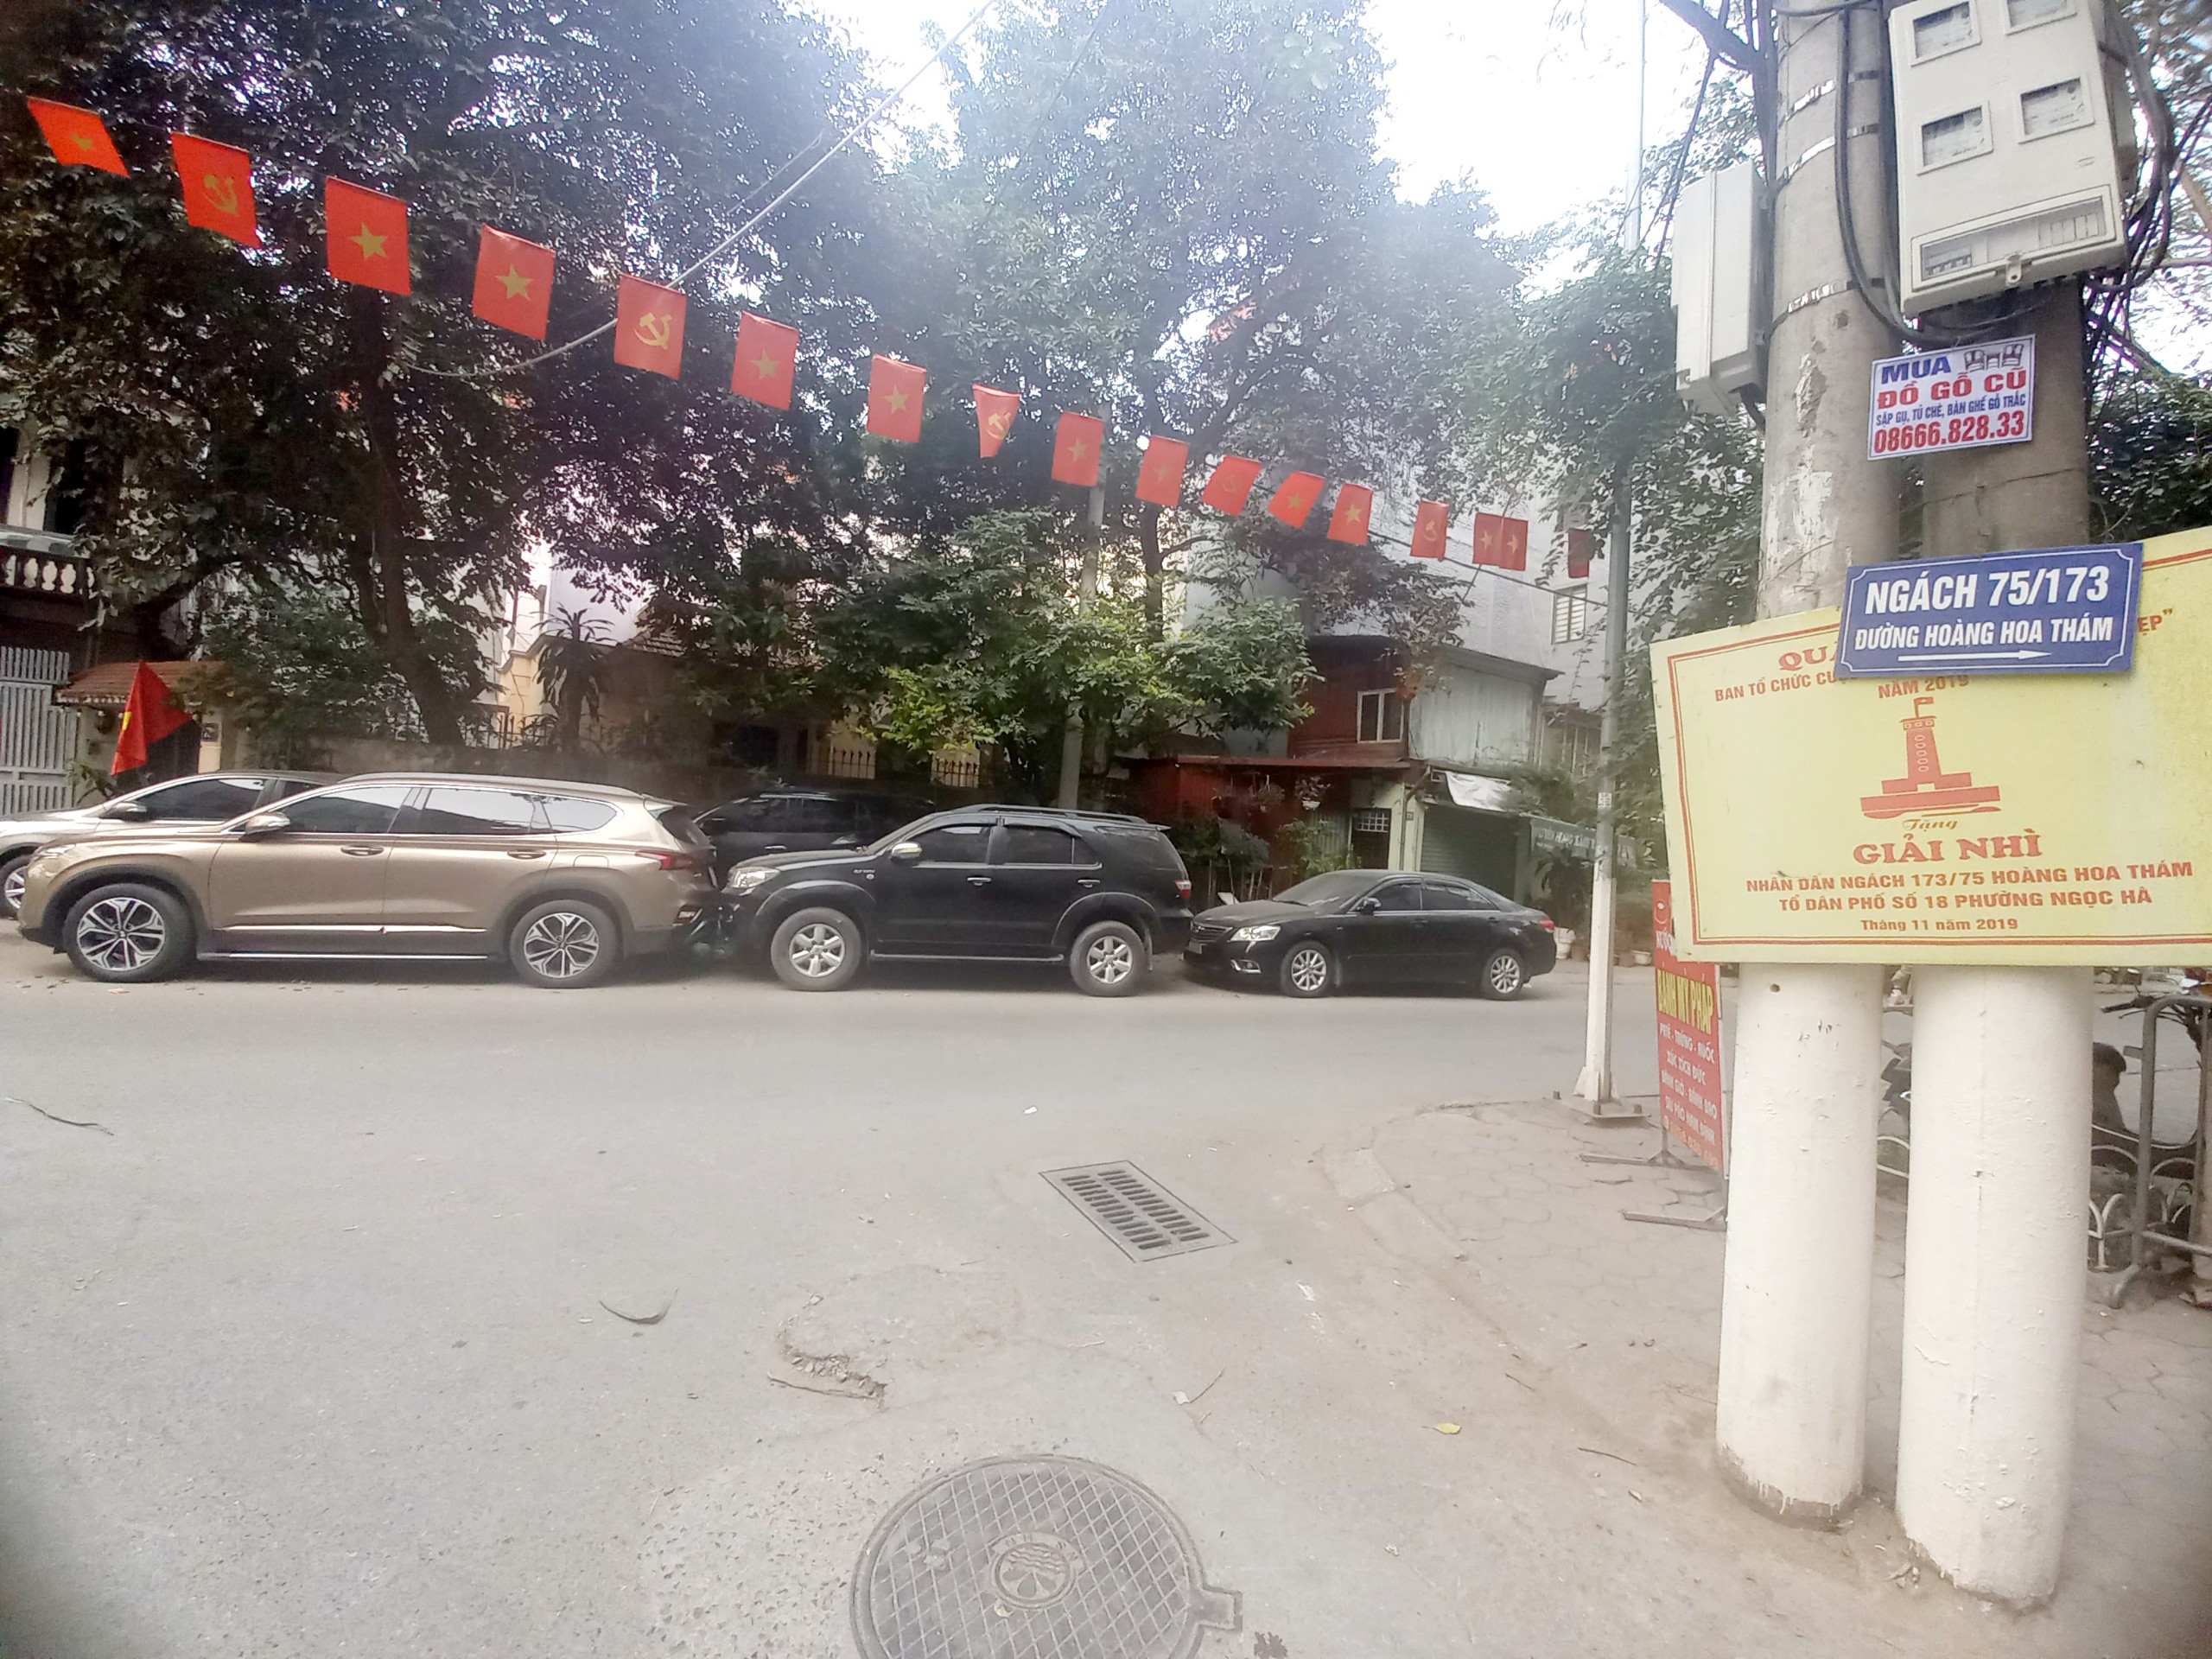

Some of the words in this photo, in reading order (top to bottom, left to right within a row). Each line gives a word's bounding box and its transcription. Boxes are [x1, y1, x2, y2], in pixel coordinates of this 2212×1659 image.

[1881, 356, 1952, 385] MUA
[1878, 380, 1919, 410] ĐỒ
[1930, 372, 1973, 400] GỖ
[1984, 366, 2027, 393] CŨ
[1947, 400, 1966, 416] BÀN
[1968, 395, 1986, 413] GHẾ
[1874, 410, 2024, 454] 08666.828.33
[1865, 570, 1979, 615] NGÁCH
[1987, 565, 2110, 607] 75/173
[1854, 622, 1919, 651] ĐƯỜNG
[1923, 619, 1994, 648] HOÀNG
[1999, 619, 2043, 645] HOA
[2050, 613, 2114, 643] THÁM
[1715, 685, 1745, 702] BAN
[1748, 677, 1765, 696] TỔ
[1770, 674, 1812, 692] CHỨC
[1816, 671, 1839, 685] CU
[2138, 607, 2174, 636] ẸP”
[1778, 645, 1838, 671] QU
[1924, 675, 1969, 692] 2019
[1902, 819, 1958, 832] Tặng
[1853, 833, 1945, 865] GIẢI
[1956, 828, 2043, 861] NHÌ
[1746, 876, 1793, 892] NHÂN
[1798, 875, 1834, 891] DÂN
[1840, 873, 1904, 889] NGÁCH
[1911, 872, 1985, 887] 173/75
[1992, 867, 2067, 885] HOÀNG
[2075, 865, 2121, 882] HOA
[2126, 860, 2193, 880] THÁM
[1779, 893, 1800, 911] TỔ
[1806, 896, 1842, 911] DÂN
[1848, 893, 1885, 910] PHỐ
[1892, 891, 1918, 909] SỐ
[1924, 894, 1948, 908] 18
[1955, 890, 2044, 908] PHƯỜNG
[2050, 891, 2113, 908] NGỌC
[2121, 887, 2152, 904] HÀ
[1860, 919, 1907, 931] Tháng
[1911, 919, 1929, 930] 11
[1936, 918, 1971, 931] năm
[1976, 918, 2018, 930] 2019
